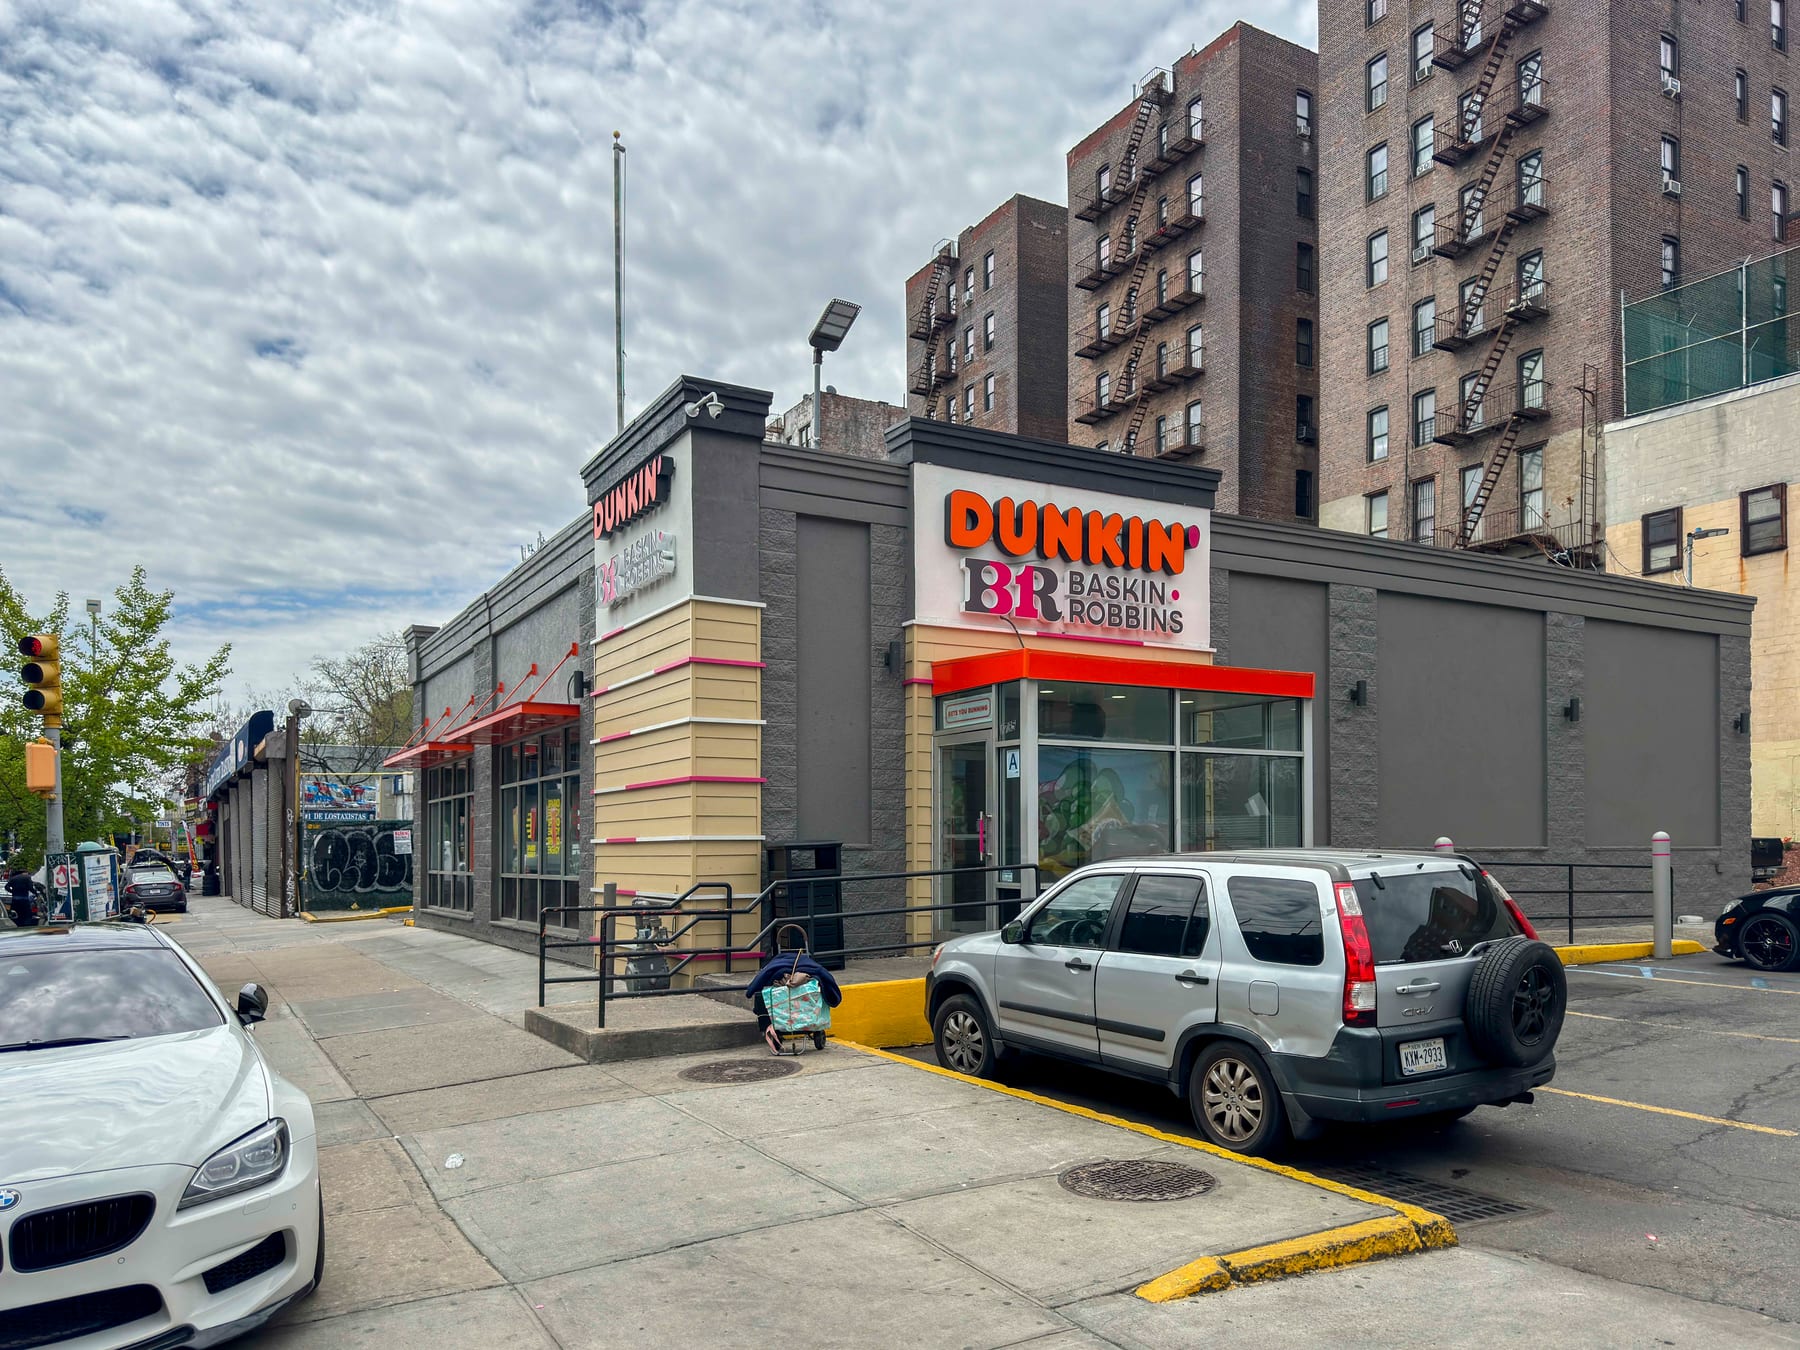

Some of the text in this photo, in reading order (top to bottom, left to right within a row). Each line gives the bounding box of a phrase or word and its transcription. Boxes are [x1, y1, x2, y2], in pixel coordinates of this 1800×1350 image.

[594, 455, 661, 540] DUNKIN'
[946, 489, 1200, 575] DUNKIN'
[1068, 570, 1166, 606] BASKIN
[1068, 600, 1184, 634] ROBBINS
[1008, 753, 1019, 770] A
[314, 812, 323, 820] DE
